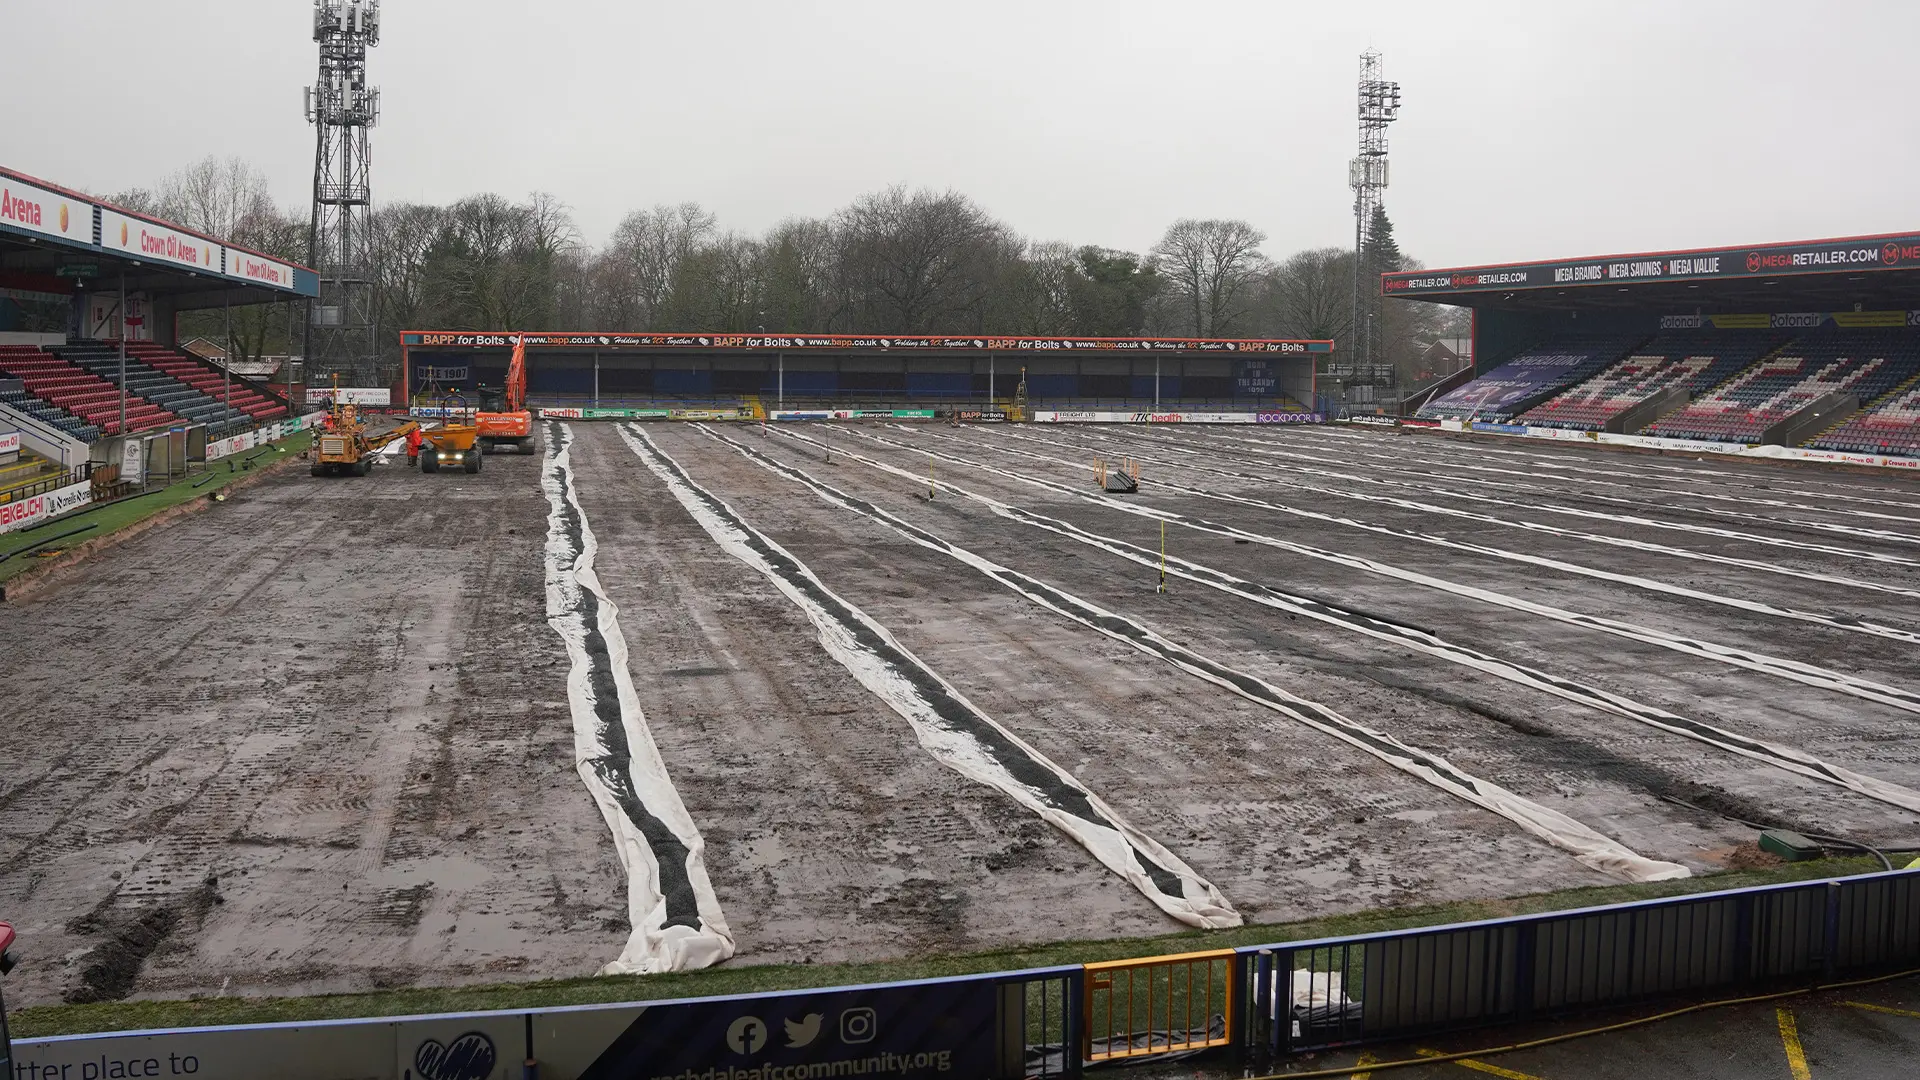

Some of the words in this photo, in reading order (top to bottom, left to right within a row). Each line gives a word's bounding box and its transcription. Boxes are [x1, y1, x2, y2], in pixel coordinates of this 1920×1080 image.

[1, 188, 41, 226] Arena
[141, 229, 165, 256] Crown
[167, 234, 177, 258] Oil
[178, 240, 197, 263] Arena
[1762, 249, 1878, 267] MEGARETAILER.COM
[246, 260, 260, 277] Crown
[267, 266, 279, 283] Arena
[1555, 268, 1574, 282] MEGA
[1574, 265, 1602, 280] BRANDS
[1608, 263, 1629, 279] MEGA
[1630, 260, 1662, 277] SAVINGS
[1669, 259, 1692, 275] MEGA
[1693, 257, 1719, 274] VALUE
[1393, 278, 1450, 289] MEGARETAILER.COM
[1460, 272, 1527, 285] MEGARETAILER.COM
[1770, 313, 1820, 327] Rotonair
[423, 335, 455, 345] BAPP
[457, 335, 474, 345] for
[477, 335, 504, 345] Bolts
[525, 336, 596, 346] www.bapp.co.uk
[614, 336, 639, 345] Holding
[640, 336, 651, 345] the
[652, 336, 665, 345] UK
[667, 336, 695, 347] Together!
[713, 337, 744, 346] BAPP
[746, 337, 762, 347] for
[764, 337, 791, 347] Bolts
[808, 338, 877, 348] www.bapp.co.uk
[894, 338, 918, 348] Holding
[919, 338, 929, 348] the
[930, 338, 942, 347] UK
[943, 339, 969, 348] Together!
[987, 339, 1016, 349] BAPP
[1018, 339, 1033, 349] for
[1034, 340, 1060, 349] Bolts
[1076, 340, 1139, 350] www.bapp.co.uk
[1154, 341, 1178, 350] Holding
[1178, 341, 1187, 350] the
[1187, 341, 1198, 350] UK
[1199, 342, 1223, 351] Together!
[1239, 342, 1265, 352] BAPP
[1266, 342, 1280, 352] for
[1281, 342, 1304, 352] Bolts
[444, 367, 467, 379] 1907
[1252, 378, 1276, 387] SANDY
[543, 408, 579, 418] health
[1151, 413, 1182, 422] health
[1259, 414, 1312, 423] ROCKDOOR
[10, 435, 18, 446] Oil
[82, 1055, 161, 1080] place
[168, 1053, 200, 1075] to
[652, 1049, 951, 1080] hdaleafccommunity.org
